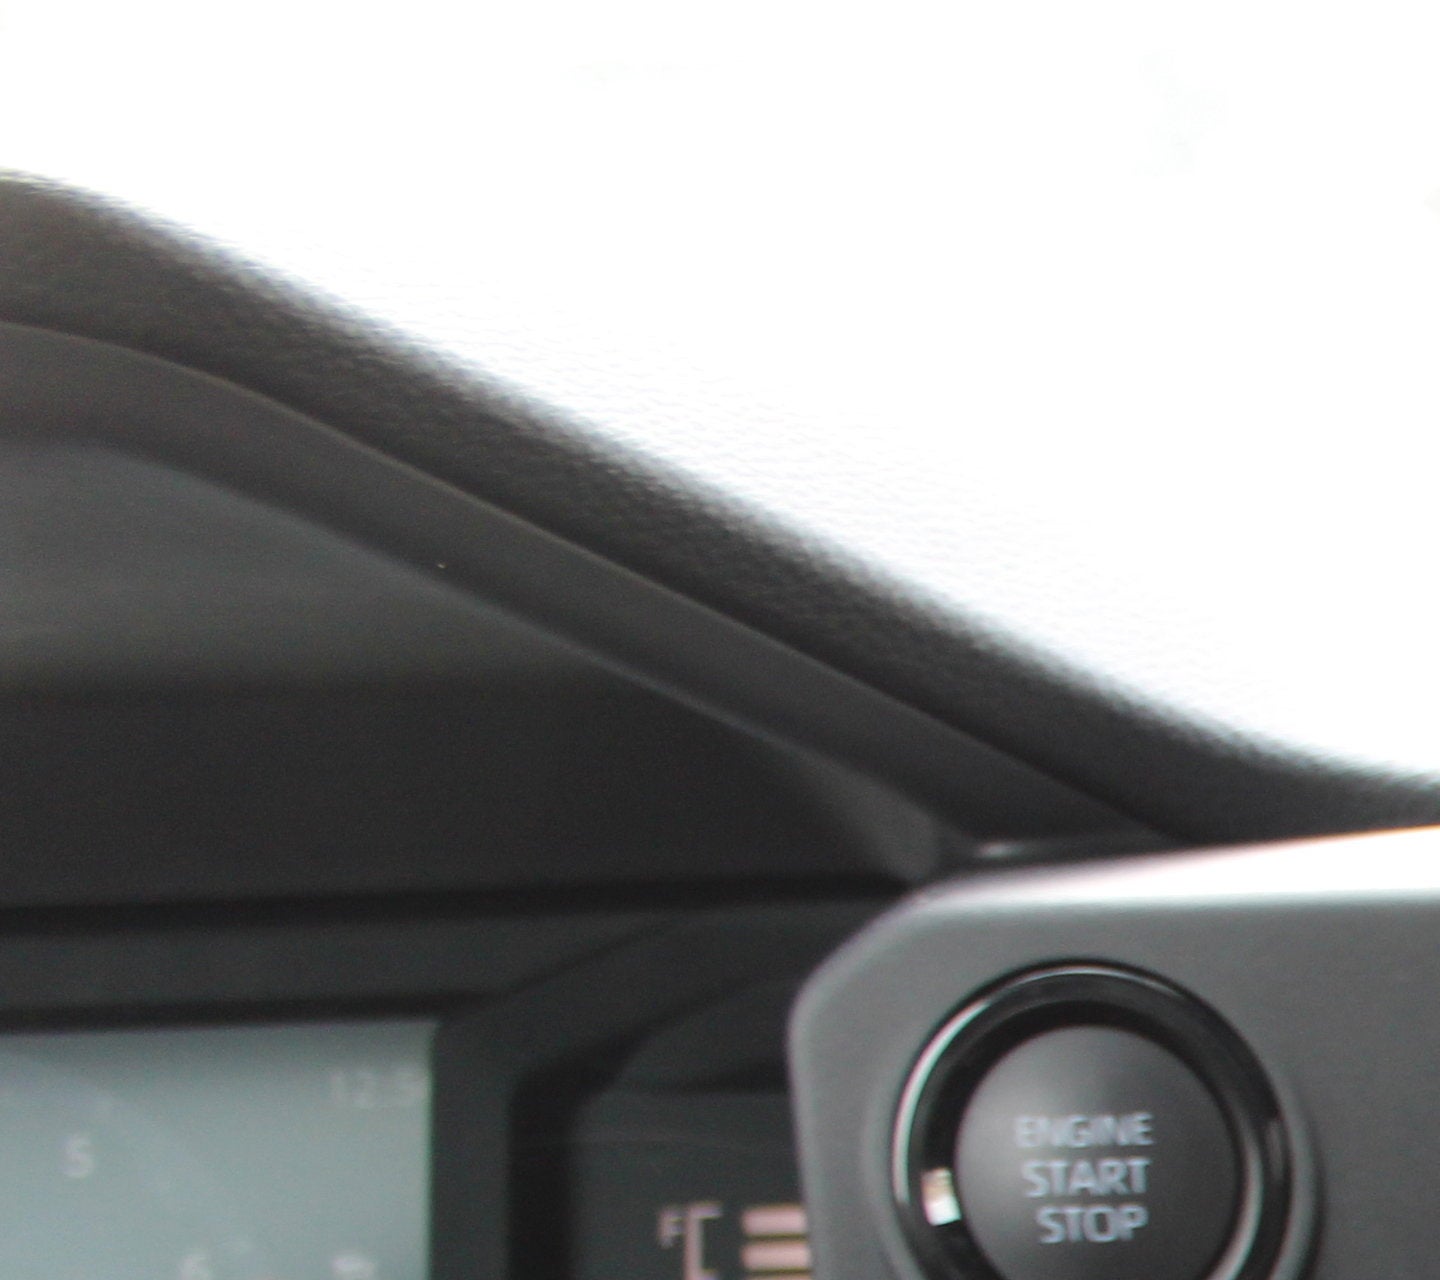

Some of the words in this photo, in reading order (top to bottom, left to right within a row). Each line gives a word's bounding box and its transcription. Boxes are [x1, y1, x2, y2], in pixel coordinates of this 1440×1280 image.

[1014, 1111, 1156, 1148] ENGINE
[64, 1132, 96, 1179] 5
[1020, 1156, 1152, 1198] START
[1035, 1204, 1149, 1245] STOP
